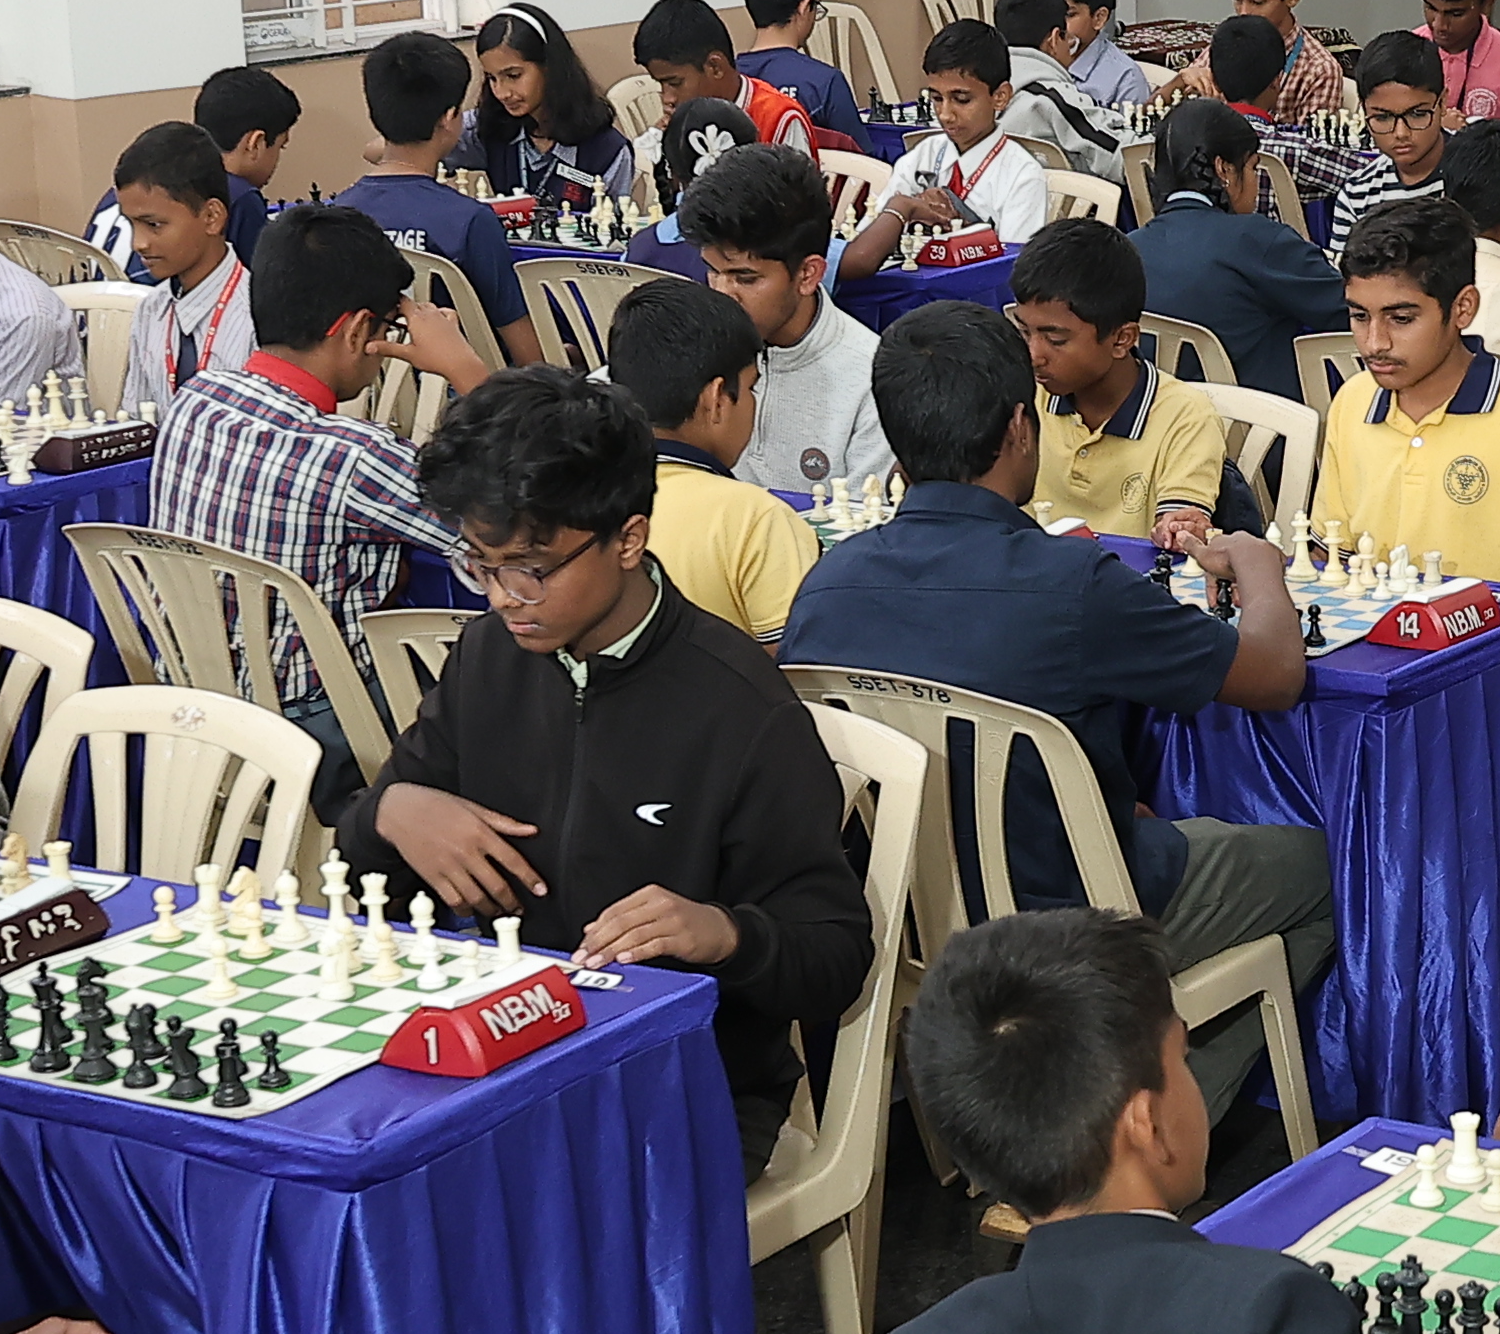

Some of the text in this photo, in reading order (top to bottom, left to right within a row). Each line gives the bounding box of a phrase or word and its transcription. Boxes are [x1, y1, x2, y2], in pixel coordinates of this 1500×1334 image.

[930, 245, 946, 260] 39
[1397, 611, 1419, 638] 14
[847, 675, 951, 705] SSET-378
[423, 1027, 438, 1064] 1
